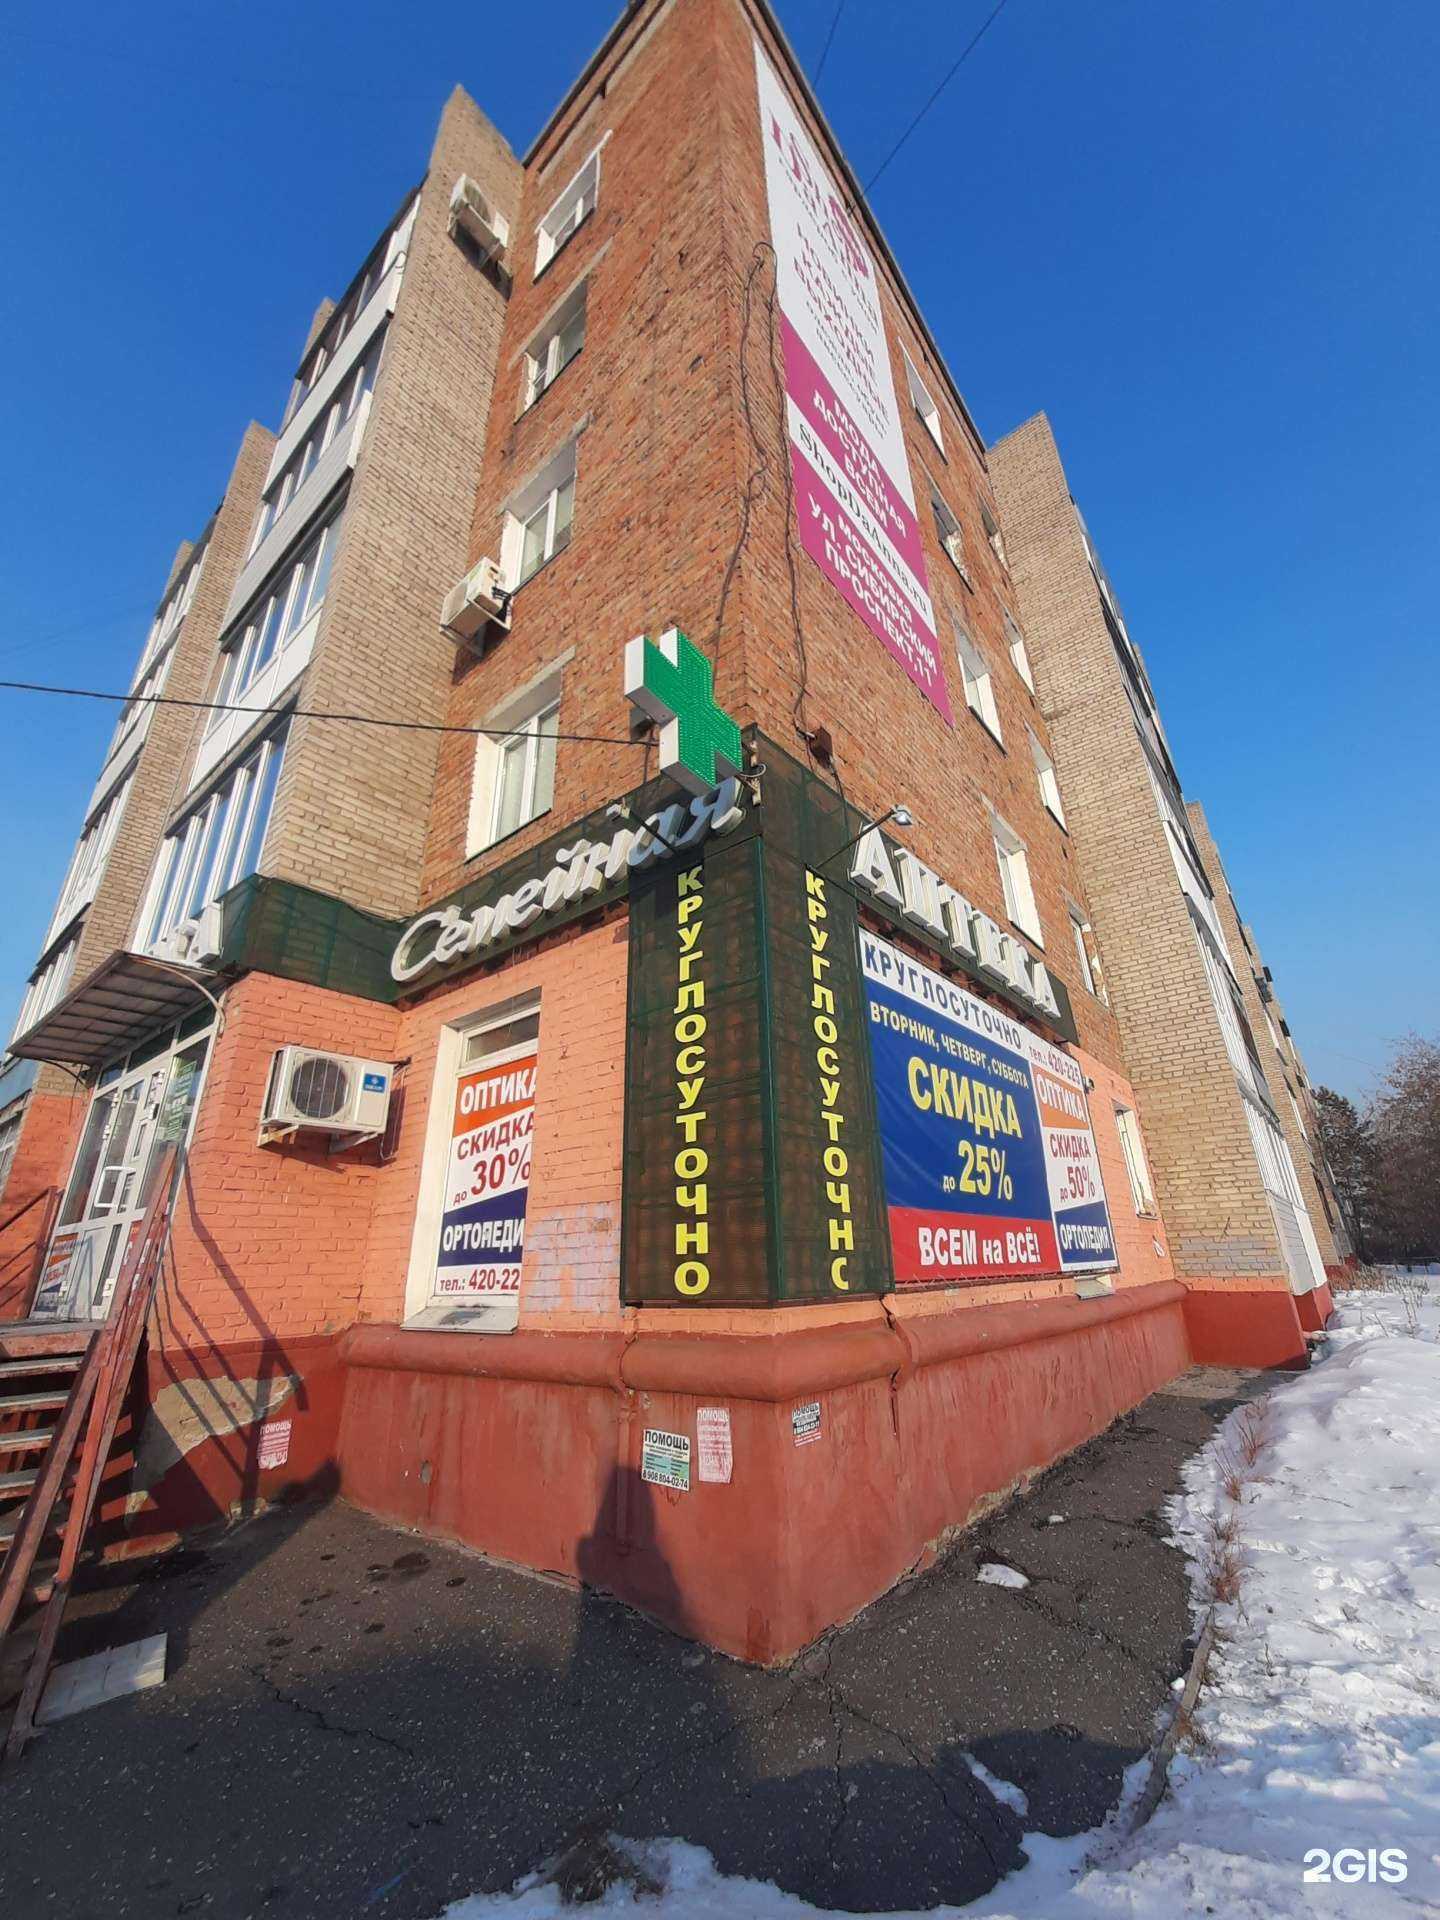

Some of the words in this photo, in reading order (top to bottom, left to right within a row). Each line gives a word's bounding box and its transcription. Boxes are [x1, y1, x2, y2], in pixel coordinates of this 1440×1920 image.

[811, 382, 906, 541] ДОСТУПНАЯ
[843, 450, 888, 530] ВСЕМ
[798, 418, 927, 616] ShopDaAnna.ru
[844, 538, 937, 677] СИБИРСКИЙ
[390, 777, 746, 982] Семейная
[849, 823, 1062, 1018] АПТЕКА
[865, 940, 1022, 1049] КРУГЛОСУТОЧНО
[674, 864, 710, 1296] КРУГЛОСУТОЧНО
[870, 1001, 939, 1051] ВТОРНИК,
[941, 1037, 991, 1074] ЧЕТВЕРГ,
[992, 1060, 1029, 1089] СУББОТА
[1048, 1050, 1081, 1085] 420-225
[907, 1056, 1022, 1139] СКИДКА
[1036, 1073, 1086, 1123] ОПТИКА
[453, 1191, 467, 1206] до
[471, 1143, 531, 1195] 30%
[958, 1140, 1013, 1200] 25%
[1049, 1133, 1091, 1162] СКИДКА
[1067, 1165, 1096, 1199] 50%
[918, 1227, 977, 1266] ВСЕМ
[982, 1240, 1004, 1264] на
[1006, 1226, 1040, 1263] ВСЁ!
[1060, 1223, 1110, 1254] ОРТОПЕДИЯ
[468, 1267, 520, 1291] 420-22
[645, 1431, 689, 1450] ПОМОЩЬ
